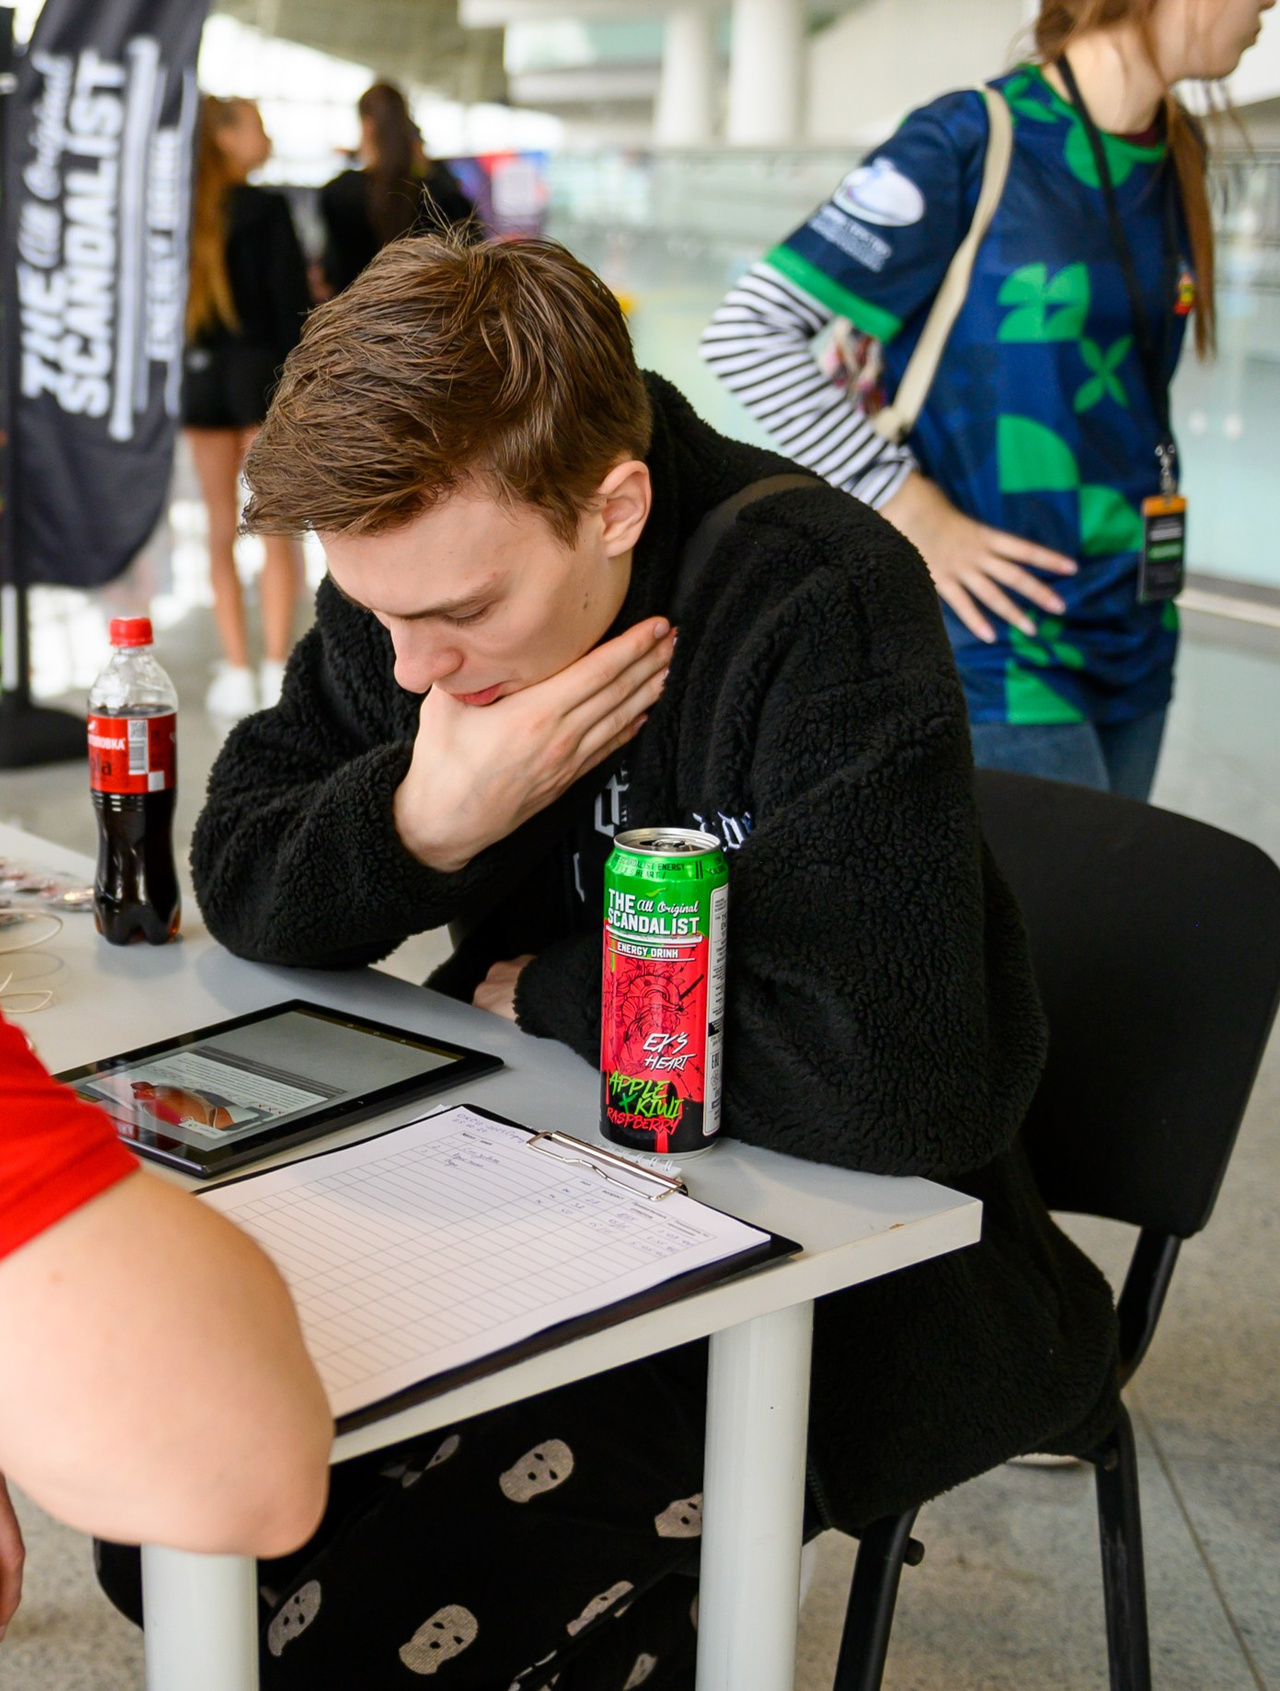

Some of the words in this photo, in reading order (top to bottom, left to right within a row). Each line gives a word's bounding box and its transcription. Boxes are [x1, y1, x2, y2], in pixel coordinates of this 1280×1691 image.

[22, 51, 74, 200] Original
[57, 50, 127, 418] SCANDALIST
[16, 264, 65, 399] THE
[658, 862, 685, 872] ENERGY
[608, 888, 636, 914] THE
[637, 900, 654, 912] All
[657, 900, 699, 917] Original
[608, 907, 700, 935] SCANDALIST
[617, 942, 648, 957] ENERGY
[650, 948, 679, 959] DRINK
[643, 1032, 689, 1054] EX'S
[645, 1053, 696, 1072] HEART
[609, 1070, 671, 1099] APPLE
[607, 1107, 682, 1135] RASPBERRY
[634, 1096, 685, 1118] KIWI
